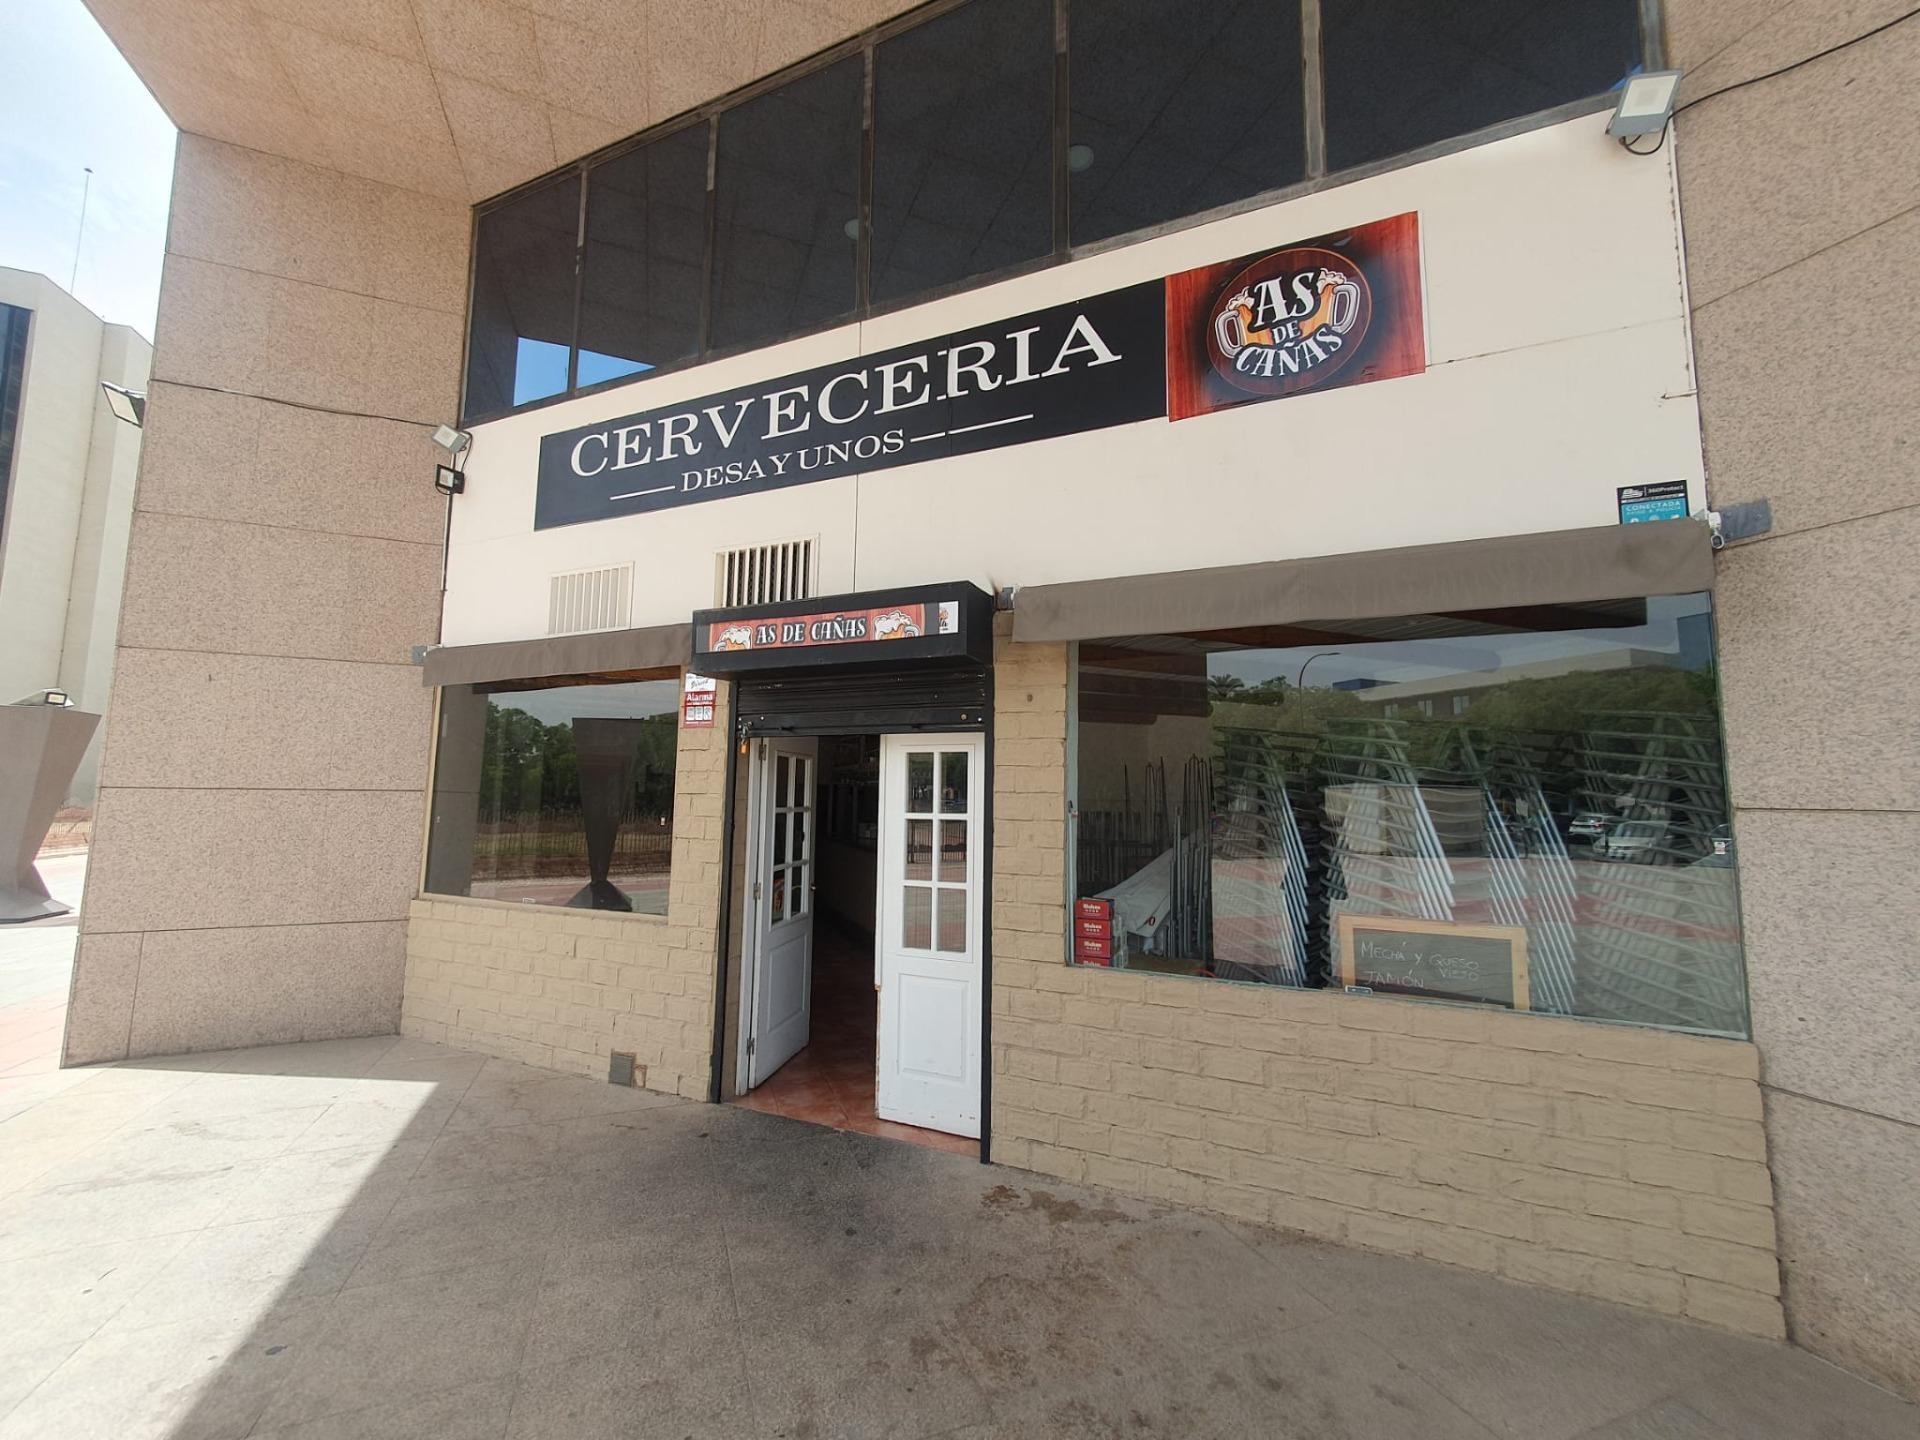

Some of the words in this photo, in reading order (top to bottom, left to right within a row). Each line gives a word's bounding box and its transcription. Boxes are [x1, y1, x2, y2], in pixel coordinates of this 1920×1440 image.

[1254, 272, 1315, 328] AS
[1272, 320, 1302, 344] DE
[1236, 327, 1342, 376] CAÑAS
[569, 314, 1122, 478] CERVECERIA
[680, 428, 905, 493] DESAYUNOS
[1625, 500, 1681, 512] CONECTADA
[756, 623, 777, 645] AS
[782, 622, 805, 642] DE
[810, 614, 867, 640] CAÑAS
[686, 692, 713, 702] Alarma
[1363, 969, 1424, 988] JAMÓN
